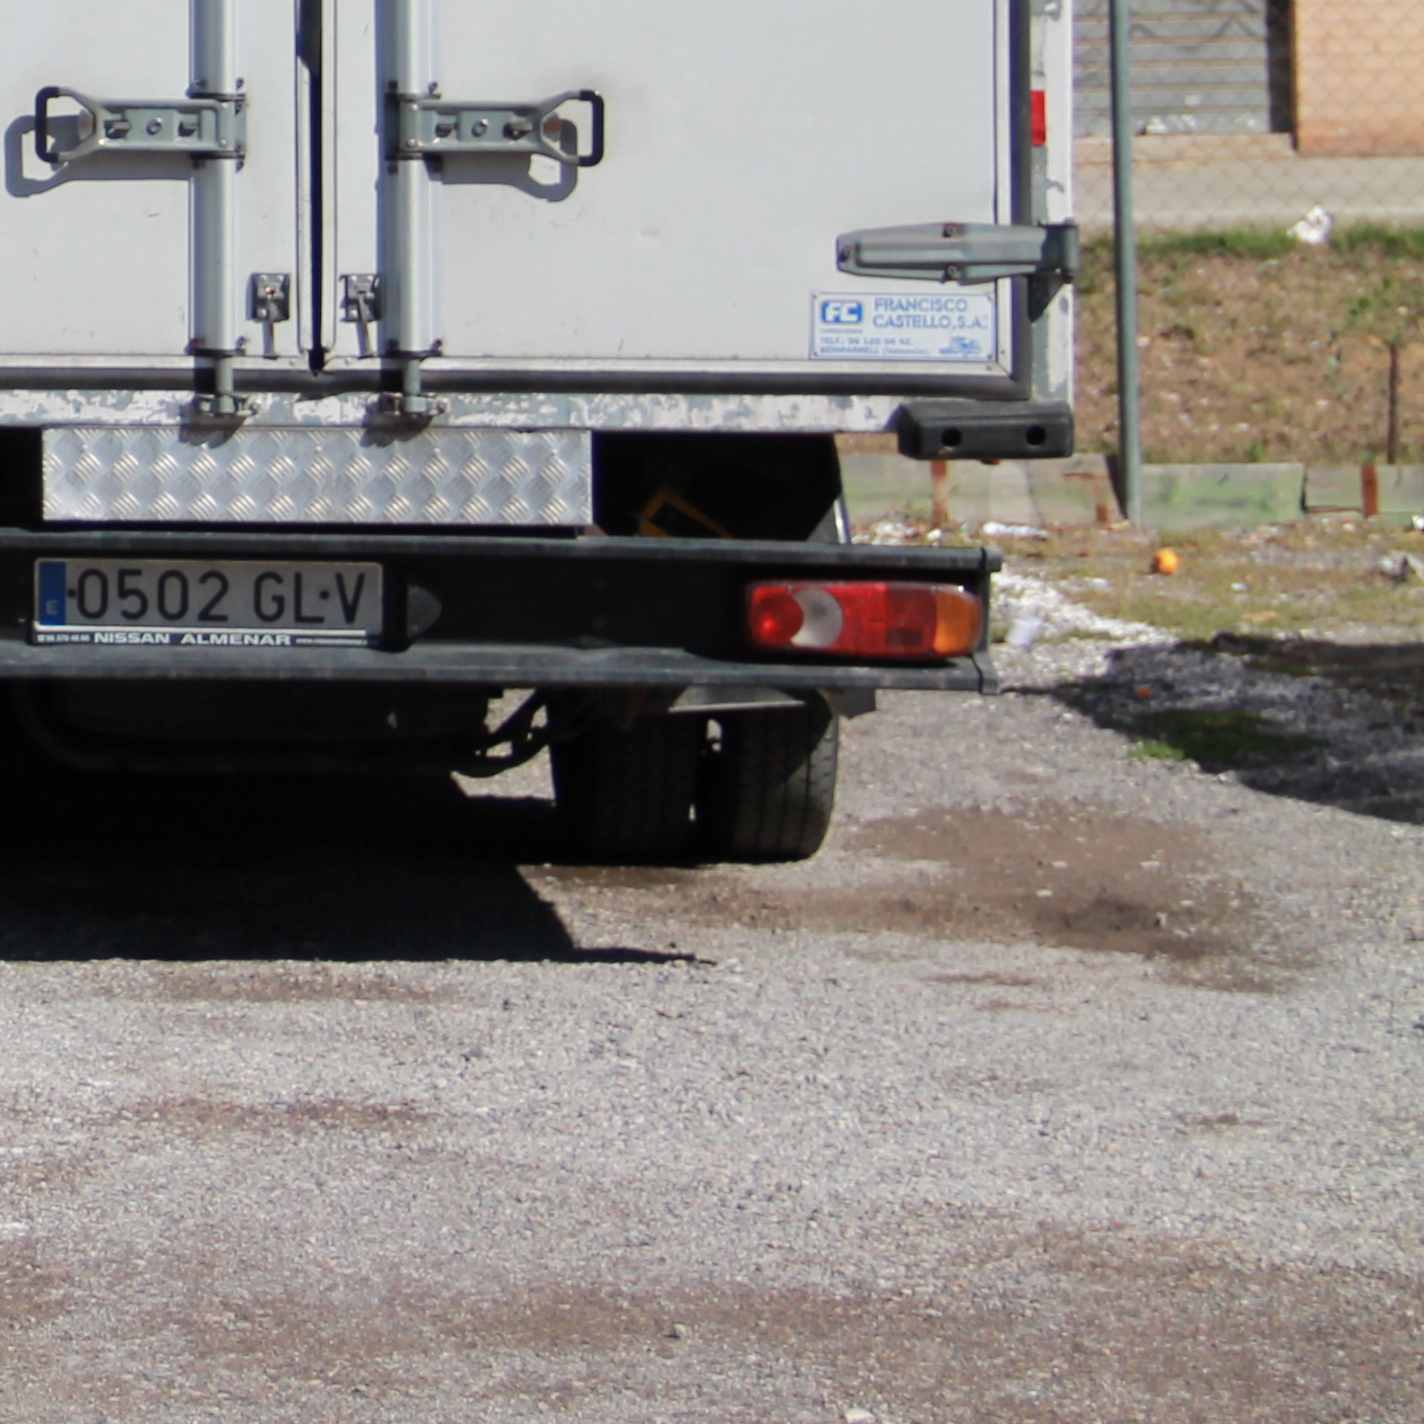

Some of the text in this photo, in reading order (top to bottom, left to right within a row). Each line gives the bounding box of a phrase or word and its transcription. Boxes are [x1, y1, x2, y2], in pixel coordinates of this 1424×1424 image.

[874, 298, 968, 312] FRANCISCO
[76, 568, 229, 622] 0502
[254, 571, 366, 625] GLV
[94, 632, 170, 644] NISSAN
[180, 633, 291, 646] ALMENAR
